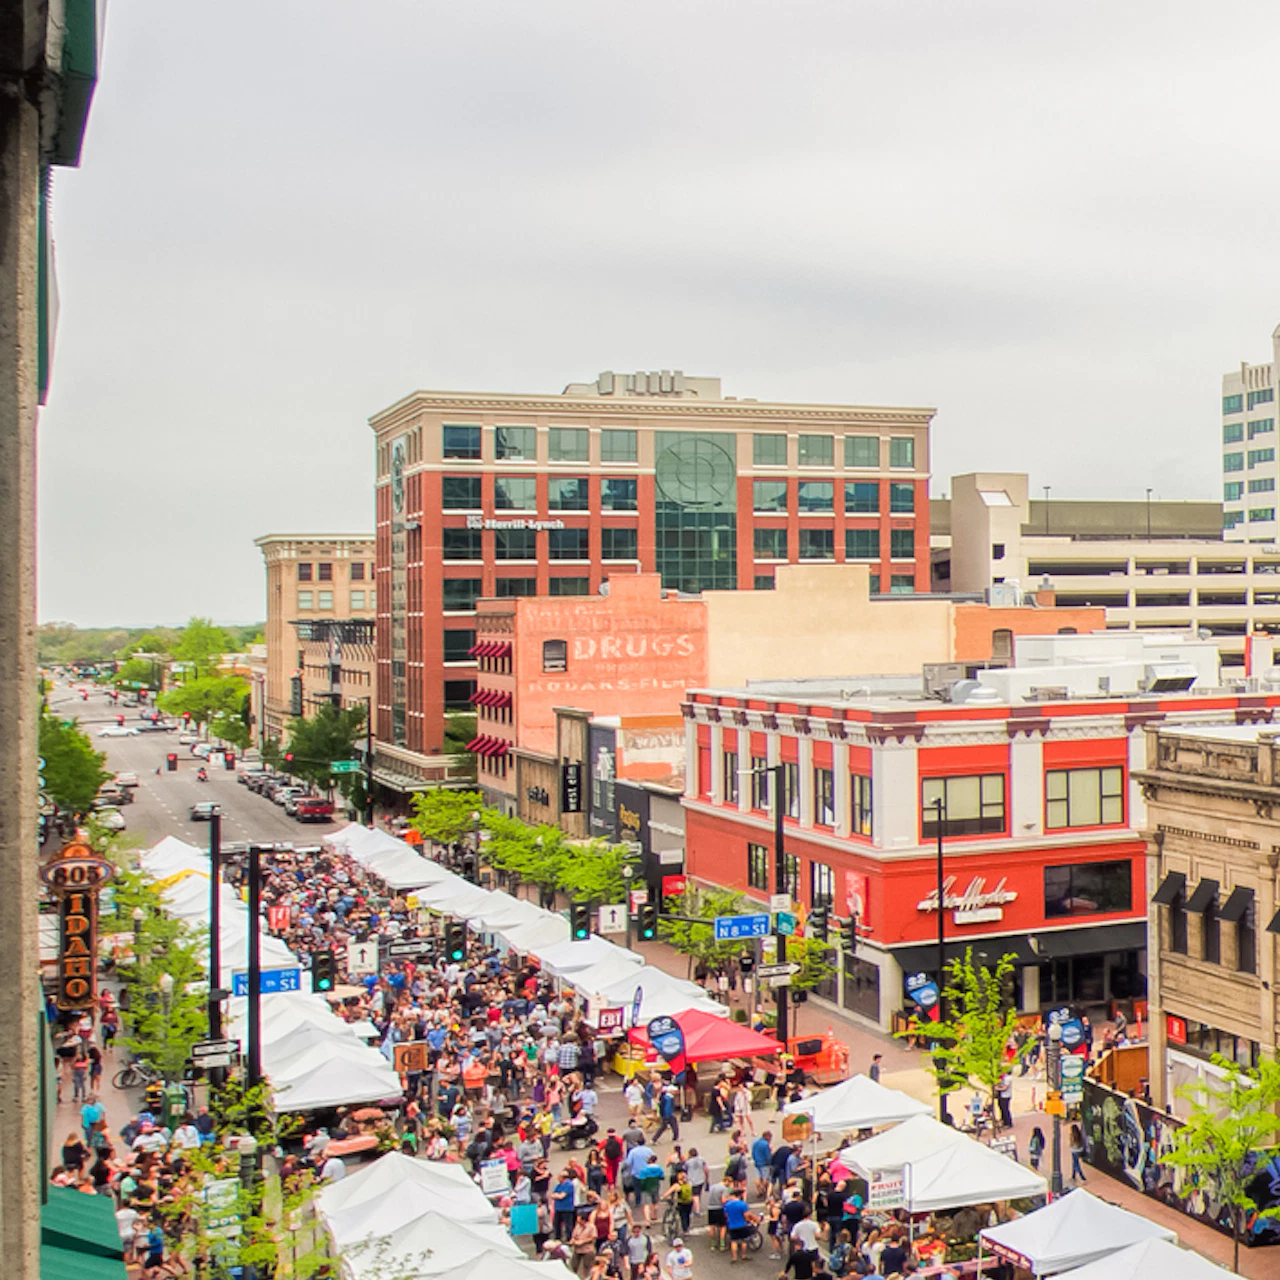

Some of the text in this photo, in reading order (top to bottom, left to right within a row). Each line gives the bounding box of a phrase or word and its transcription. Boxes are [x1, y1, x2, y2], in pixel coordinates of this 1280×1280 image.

[485, 519, 525, 530] Merrill
[528, 518, 565, 531] Lynch
[573, 633, 696, 661] DRUGS
[720, 927, 729, 937] N
[64, 893, 90, 998] IDAHO
[280, 978, 296, 991] St
[601, 1012, 621, 1028] EBT
